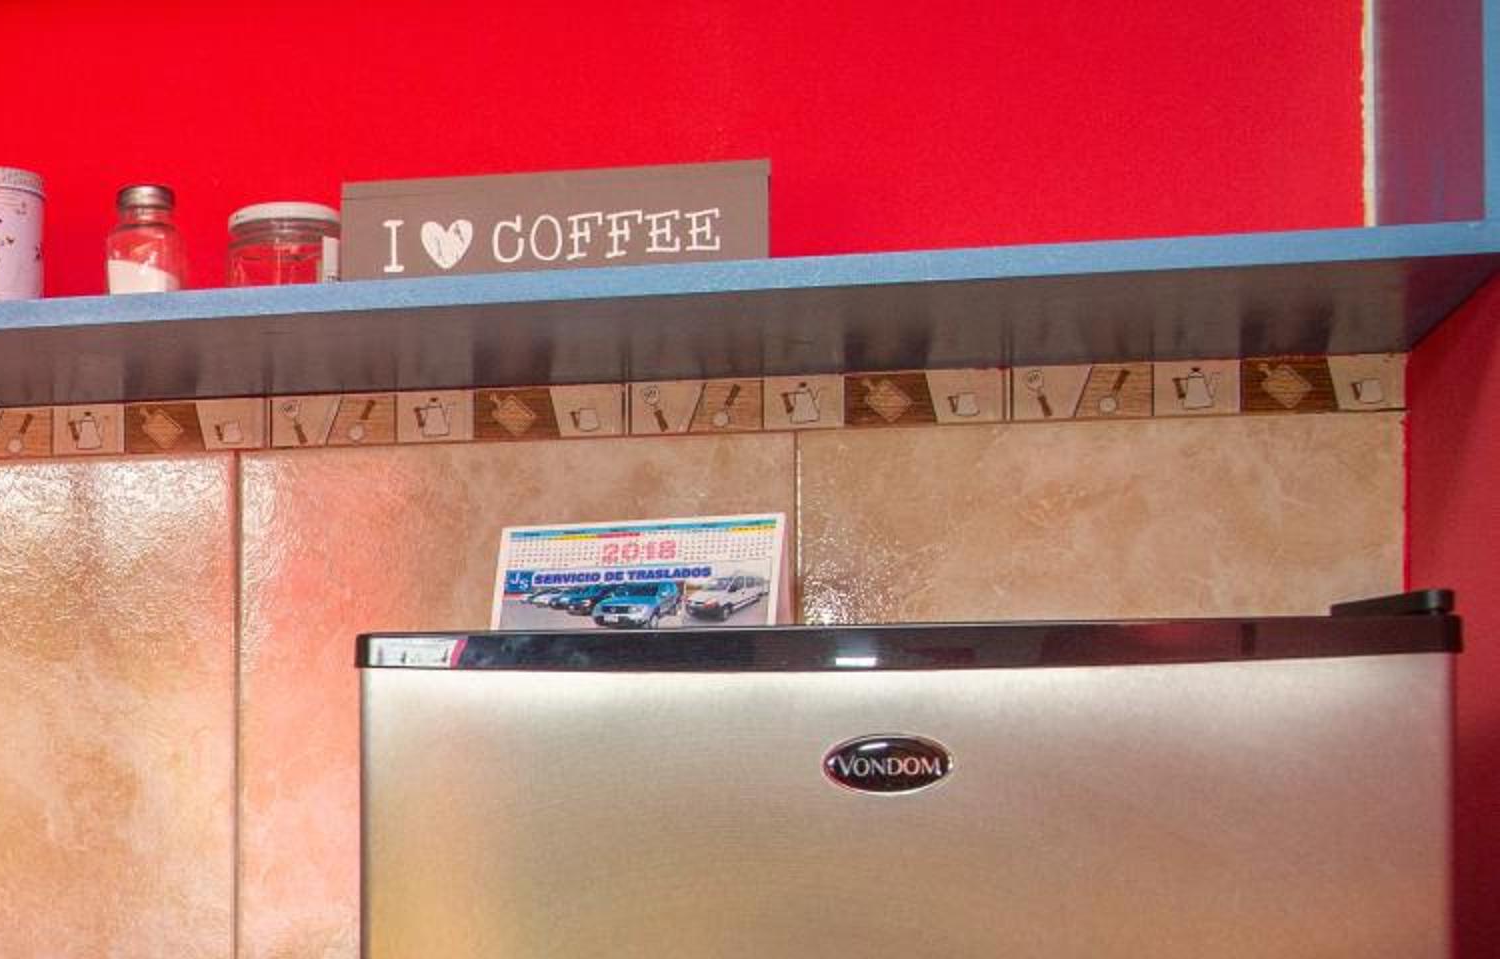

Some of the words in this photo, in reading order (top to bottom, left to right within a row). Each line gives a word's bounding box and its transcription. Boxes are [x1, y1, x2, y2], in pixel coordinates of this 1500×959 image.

[383, 219, 405, 274] I
[492, 207, 722, 264] COFFEE
[601, 540, 677, 564] 2018
[532, 571, 601, 585] SERVICIO
[603, 570, 624, 581] DE
[627, 566, 712, 580] TRASLADOS
[836, 755, 942, 777] VONDOM
